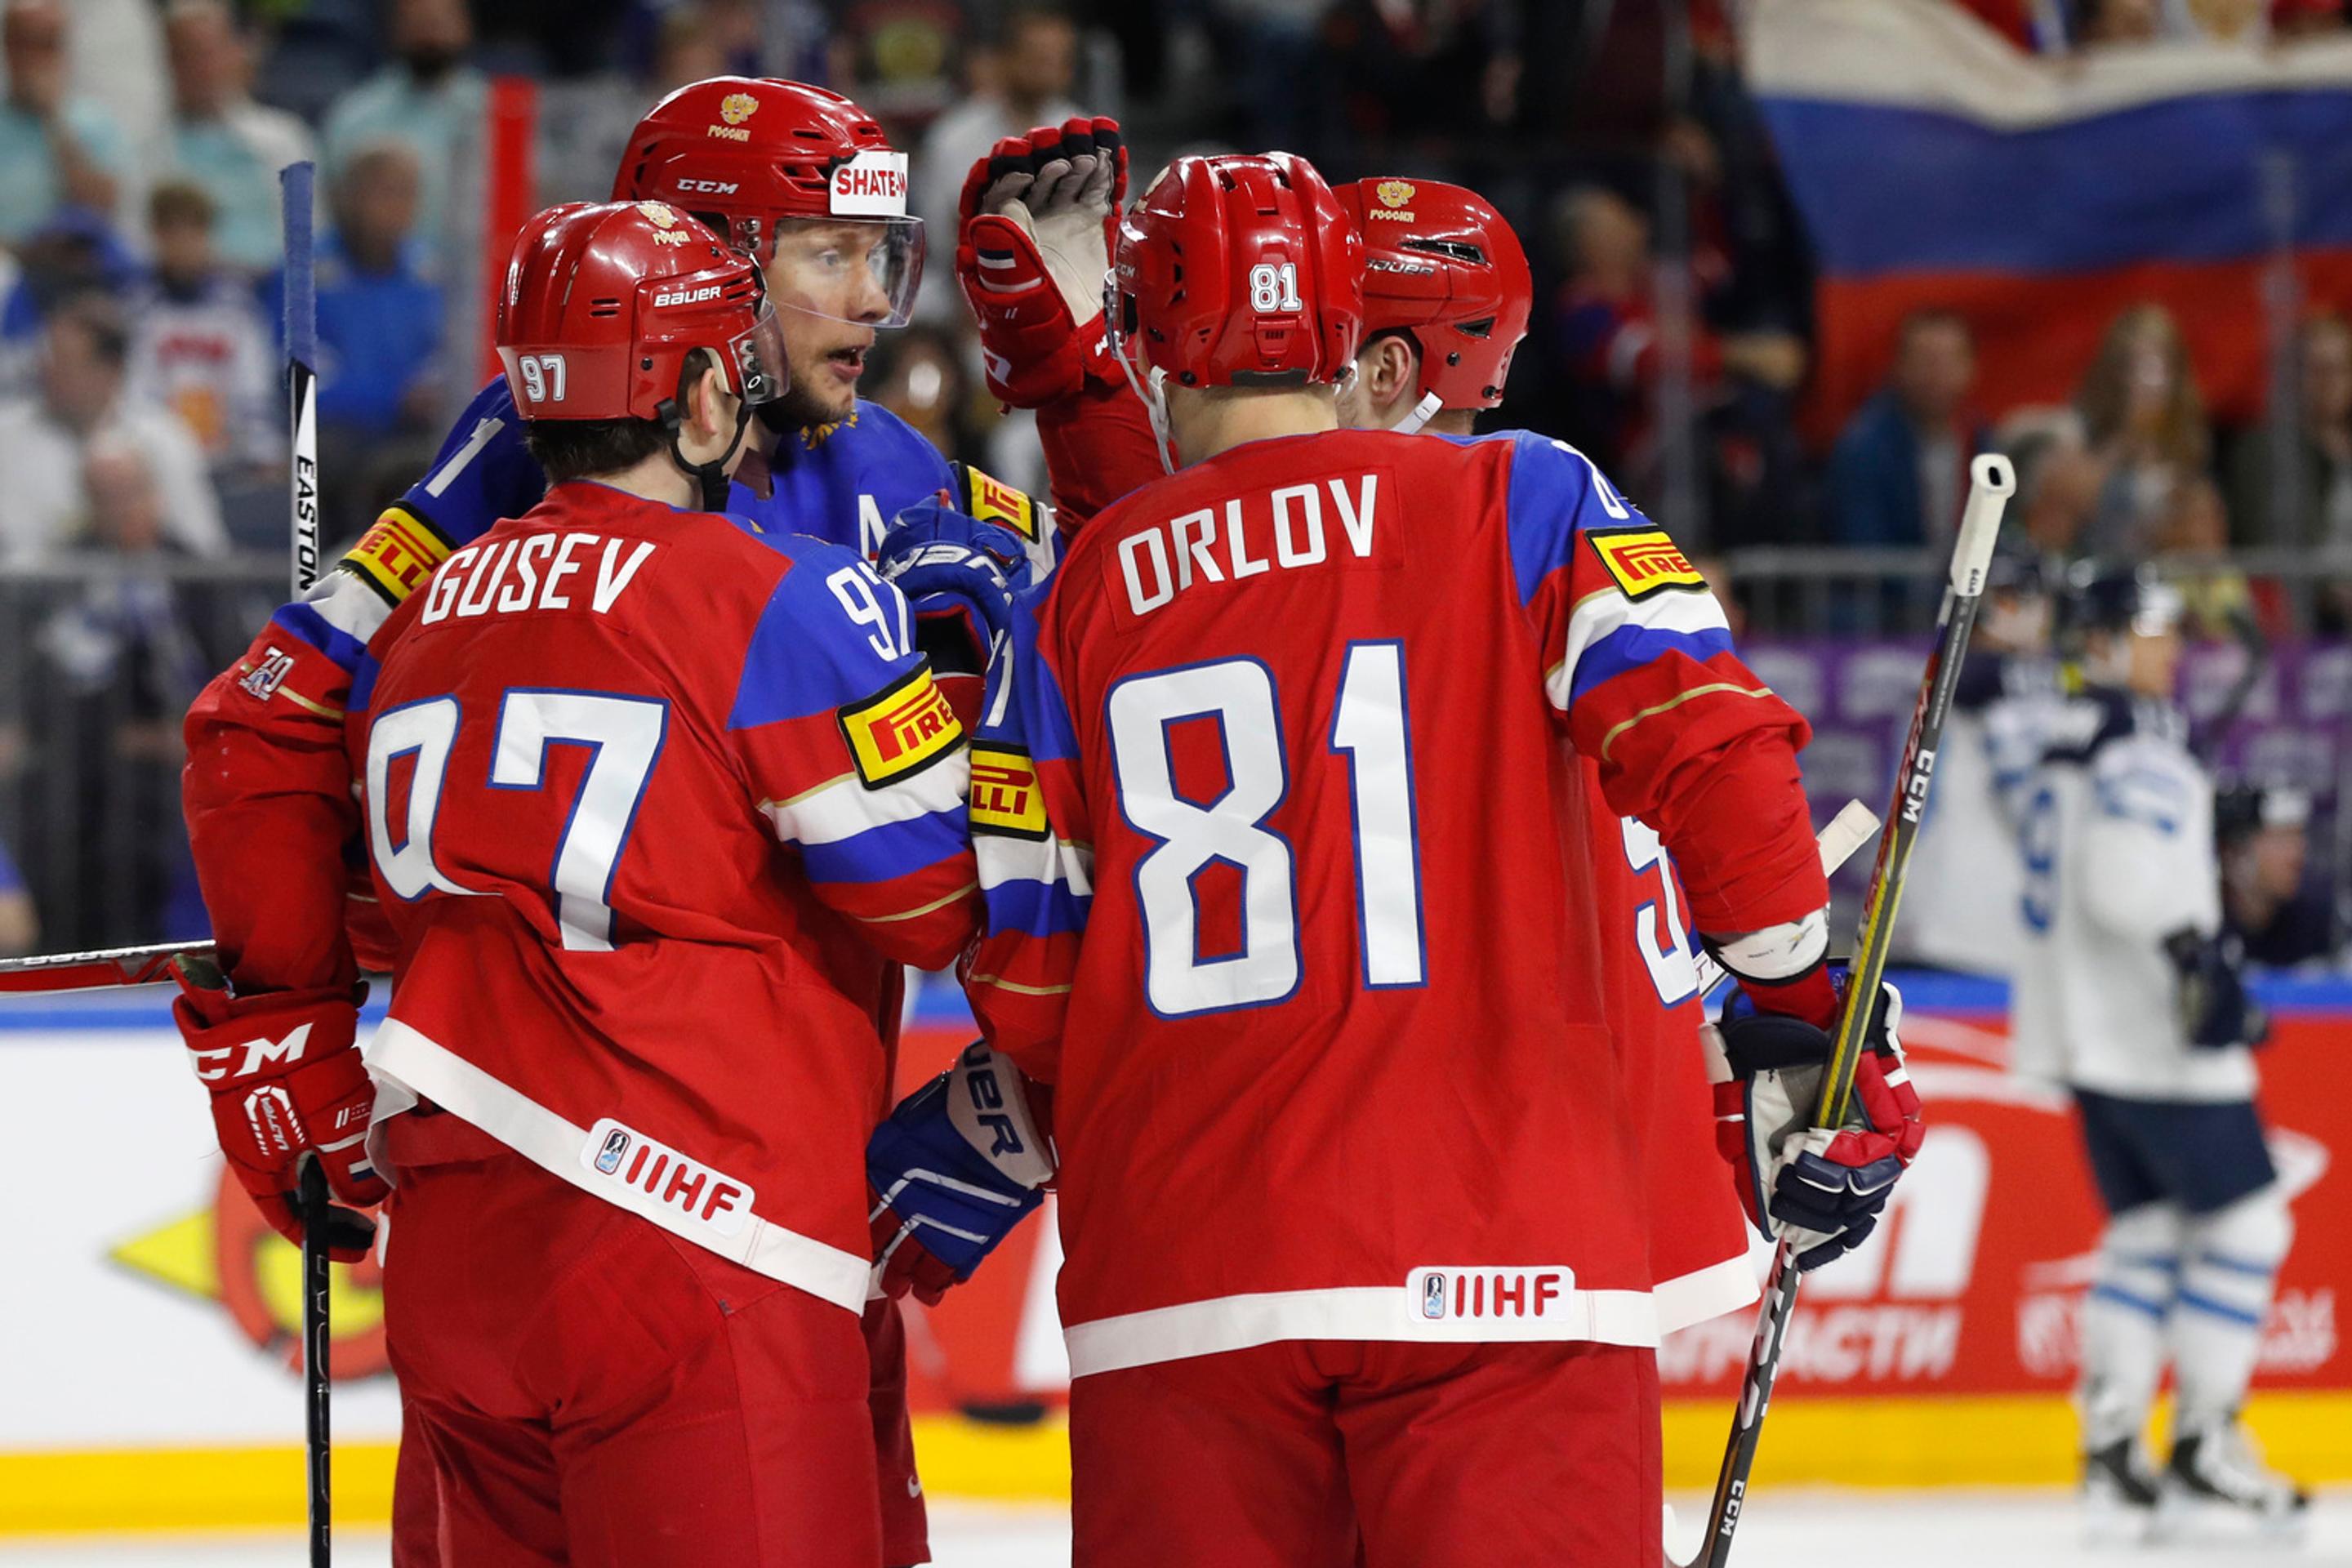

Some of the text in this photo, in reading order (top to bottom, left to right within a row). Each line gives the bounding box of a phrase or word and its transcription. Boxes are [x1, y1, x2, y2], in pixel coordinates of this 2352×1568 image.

[677, 179, 739, 194] CCM
[654, 286, 721, 307] BAUER
[1250, 263, 1303, 313] 81
[519, 354, 567, 403] 97
[296, 455, 318, 591] EASTON
[1118, 474, 1378, 616] ORLOV
[421, 532, 656, 625] GUSEV
[826, 562, 911, 662] 97
[367, 687, 670, 952] 97
[1903, 749, 1936, 823] CCM
[1105, 639, 1428, 1021] 81
[626, 1144, 741, 1221] IIHF
[1455, 1274, 1561, 1316] IIHF
[1721, 1479, 1746, 1537] CCM
